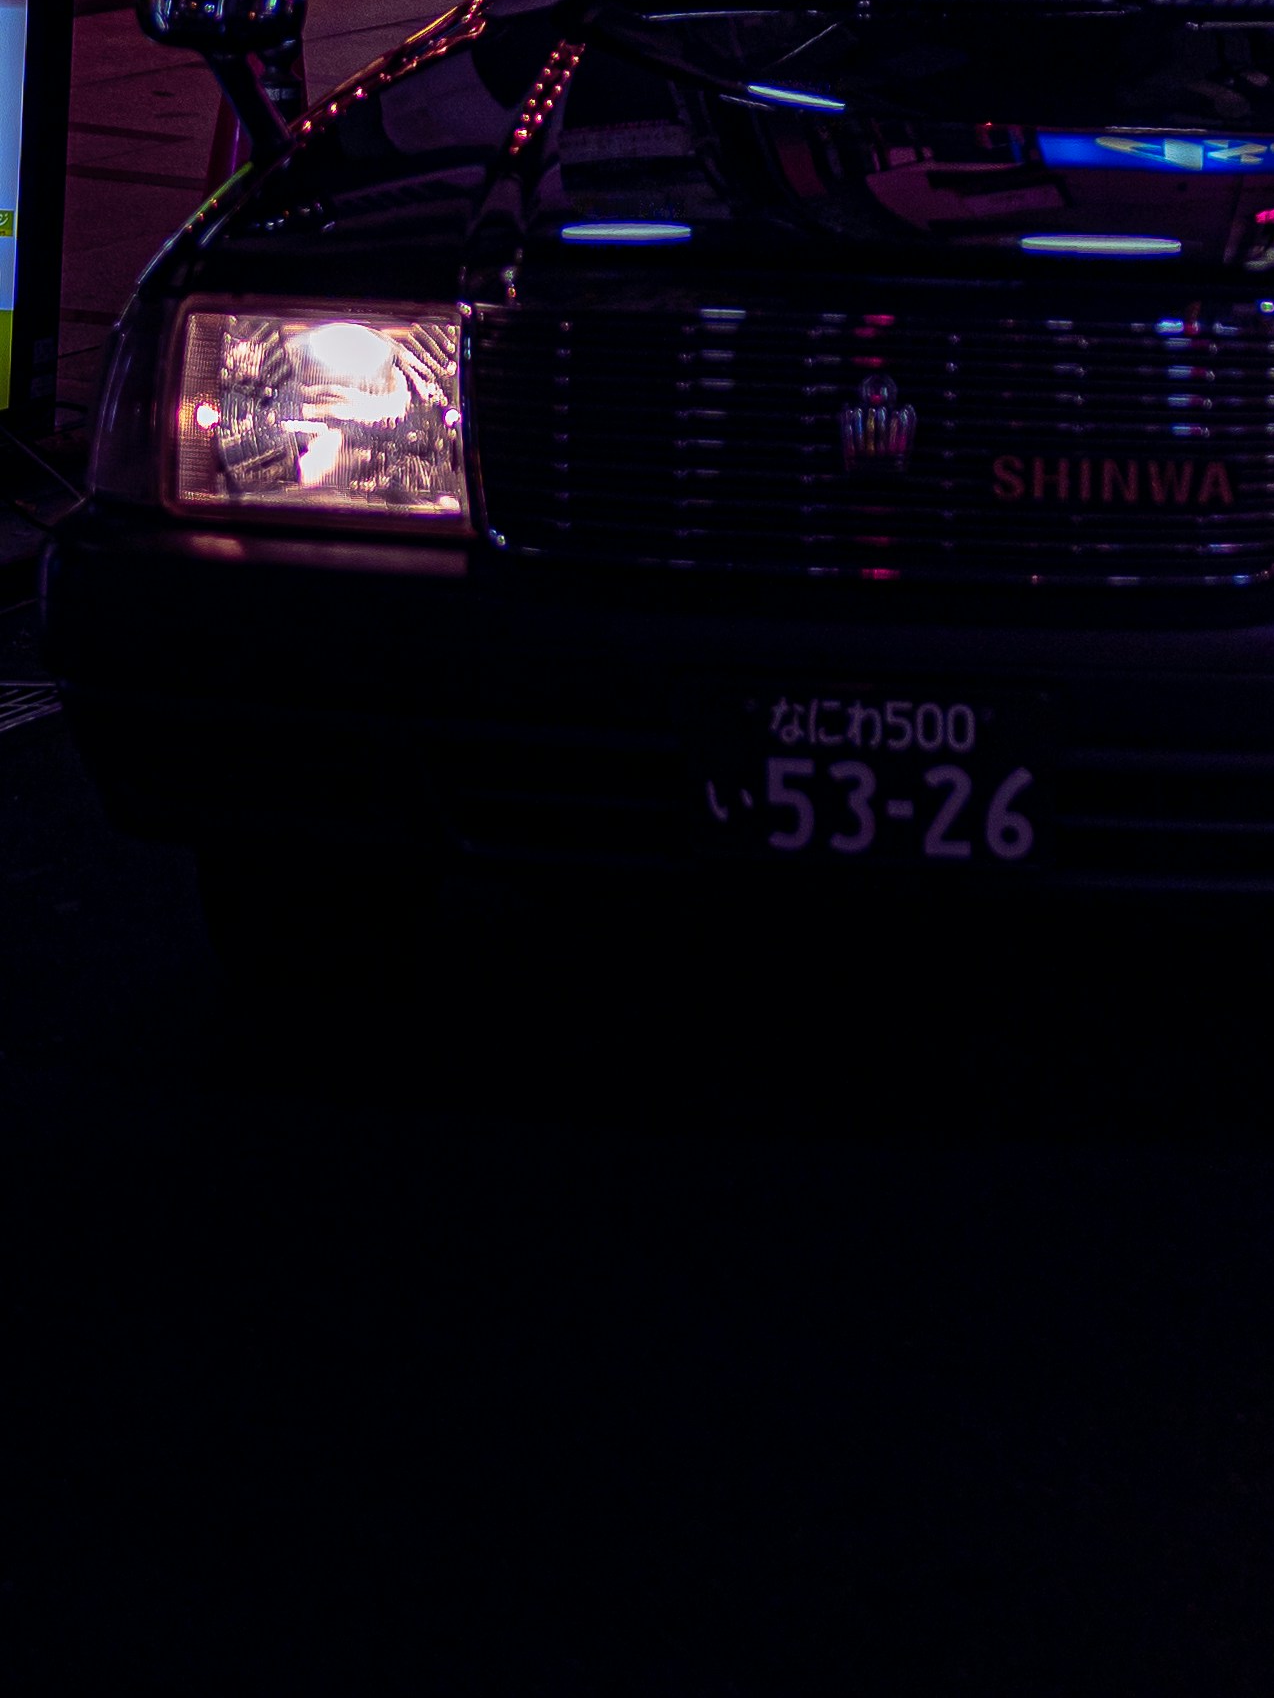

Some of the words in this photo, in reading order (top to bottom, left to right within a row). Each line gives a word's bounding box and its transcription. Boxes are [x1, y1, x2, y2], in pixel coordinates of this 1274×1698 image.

[990, 454, 1236, 504] SHINWA
[769, 695, 977, 754] なにわ500
[705, 778, 755, 823] い
[765, 756, 1036, 861] 53-26
